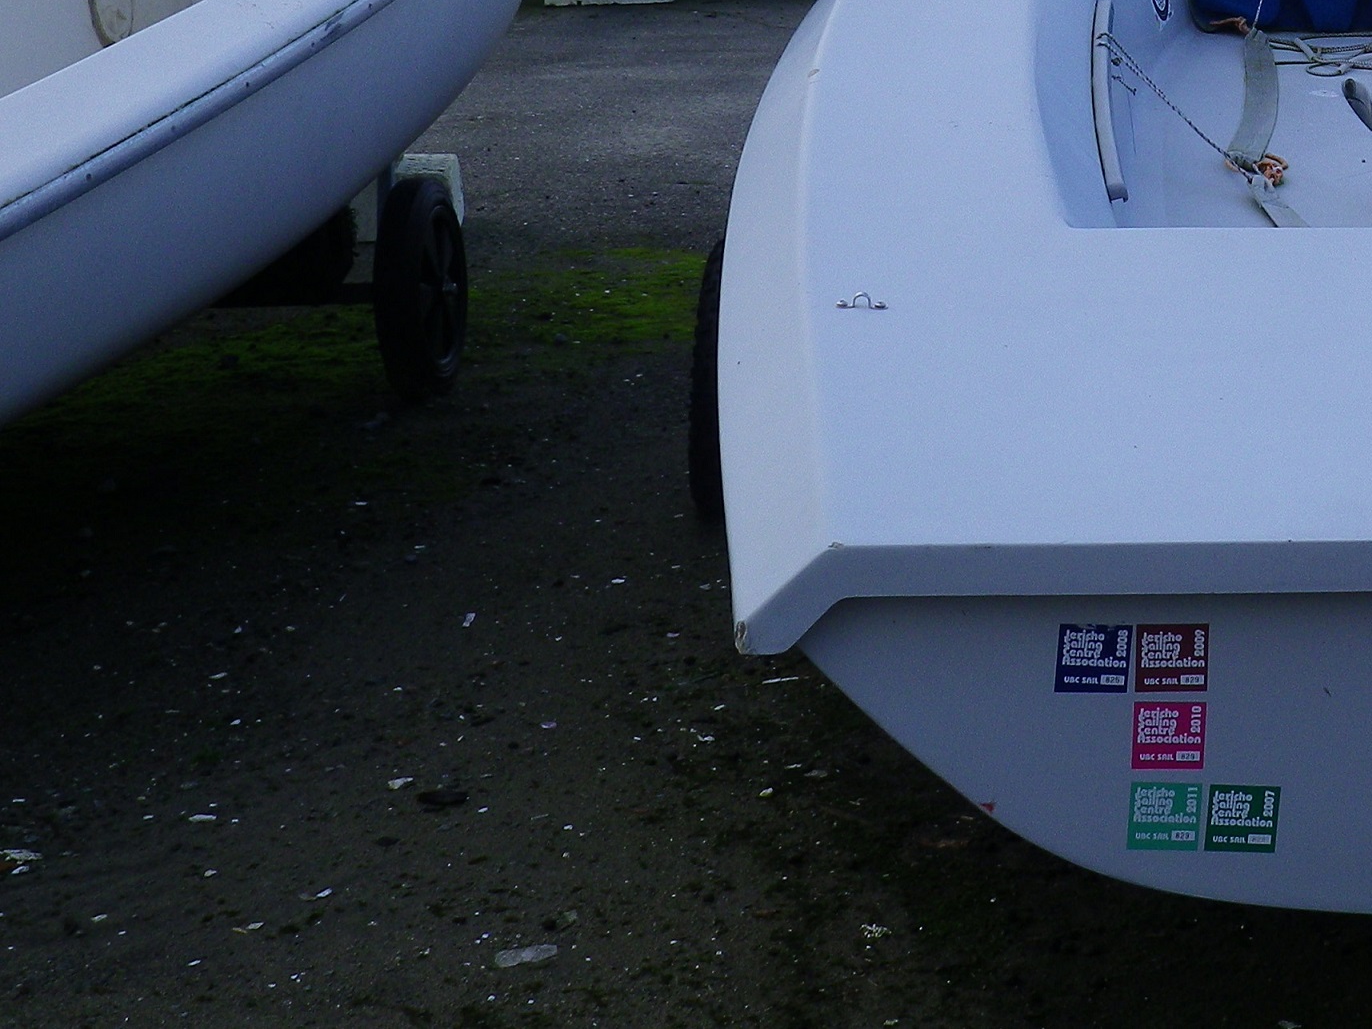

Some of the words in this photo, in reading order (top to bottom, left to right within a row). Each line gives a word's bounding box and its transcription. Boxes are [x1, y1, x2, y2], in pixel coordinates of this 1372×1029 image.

[1065, 629, 1105, 641] Jericho
[1143, 631, 1183, 642] Jericho
[1064, 637, 1103, 652] Sailing
[1116, 629, 1128, 658] 2008
[1141, 638, 1180, 652] Sailing
[1194, 629, 1206, 657] 2009
[1063, 647, 1101, 658] Centre
[1141, 649, 1179, 660] Centre
[1062, 657, 1127, 668] Association
[1141, 656, 1206, 668] Association
[1063, 676, 1080, 684] UBC
[1144, 677, 1160, 685] UBC
[1140, 707, 1179, 718] Jericho
[1138, 714, 1177, 728] Sailing
[1190, 705, 1202, 733] 2010
[1138, 725, 1175, 736] Centre
[1137, 733, 1201, 744] Association
[1139, 753, 1155, 761] UBC
[1136, 786, 1175, 798] Jericho
[1214, 790, 1253, 802] Jericho
[1134, 793, 1173, 807] Sailing
[1186, 786, 1198, 813] 2011
[1212, 797, 1250, 811] Sailing
[1263, 790, 1276, 818] 2007
[1134, 804, 1172, 815] Centre
[1212, 808, 1249, 819] Centre
[1133, 812, 1197, 824] Association
[1210, 816, 1273, 828] Association
[1135, 832, 1151, 840] UBC
[1212, 835, 1228, 843] UBC
